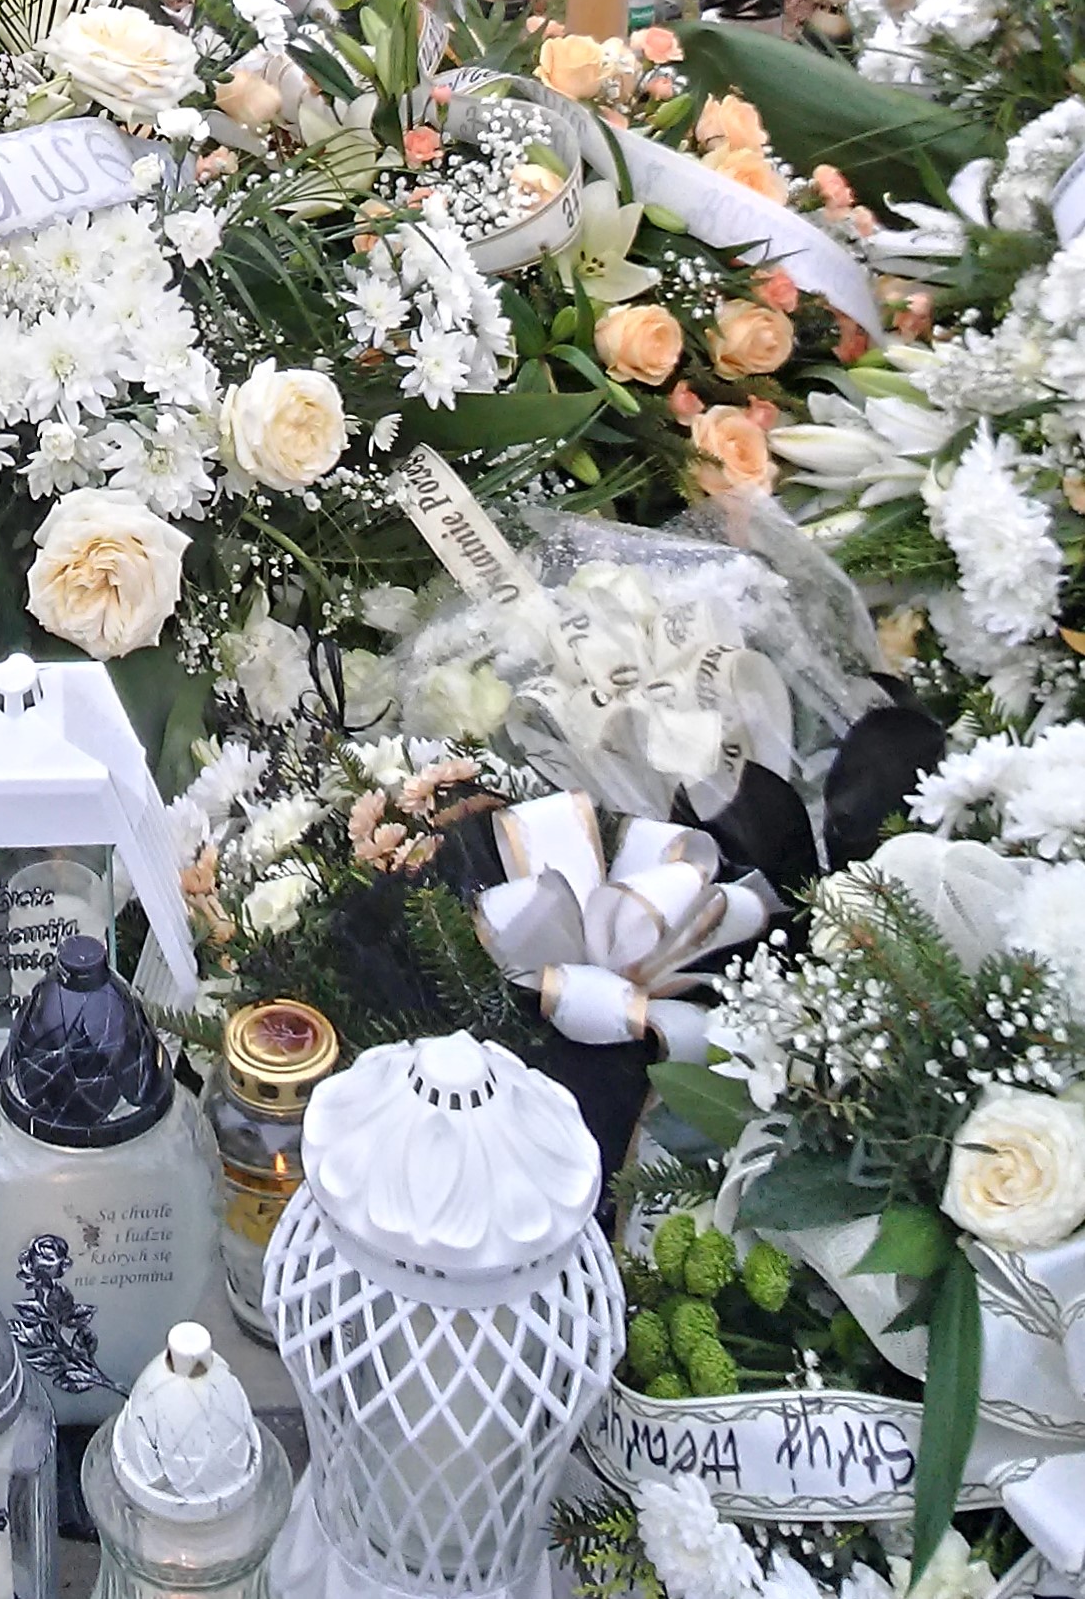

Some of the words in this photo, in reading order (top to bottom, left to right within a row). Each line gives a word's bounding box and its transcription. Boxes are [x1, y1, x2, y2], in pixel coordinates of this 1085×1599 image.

[121, 1202, 173, 1220] chwile
[125, 1226, 173, 1243] ludzie
[91, 1249, 147, 1266] których
[100, 1271, 174, 1289] zapomina
